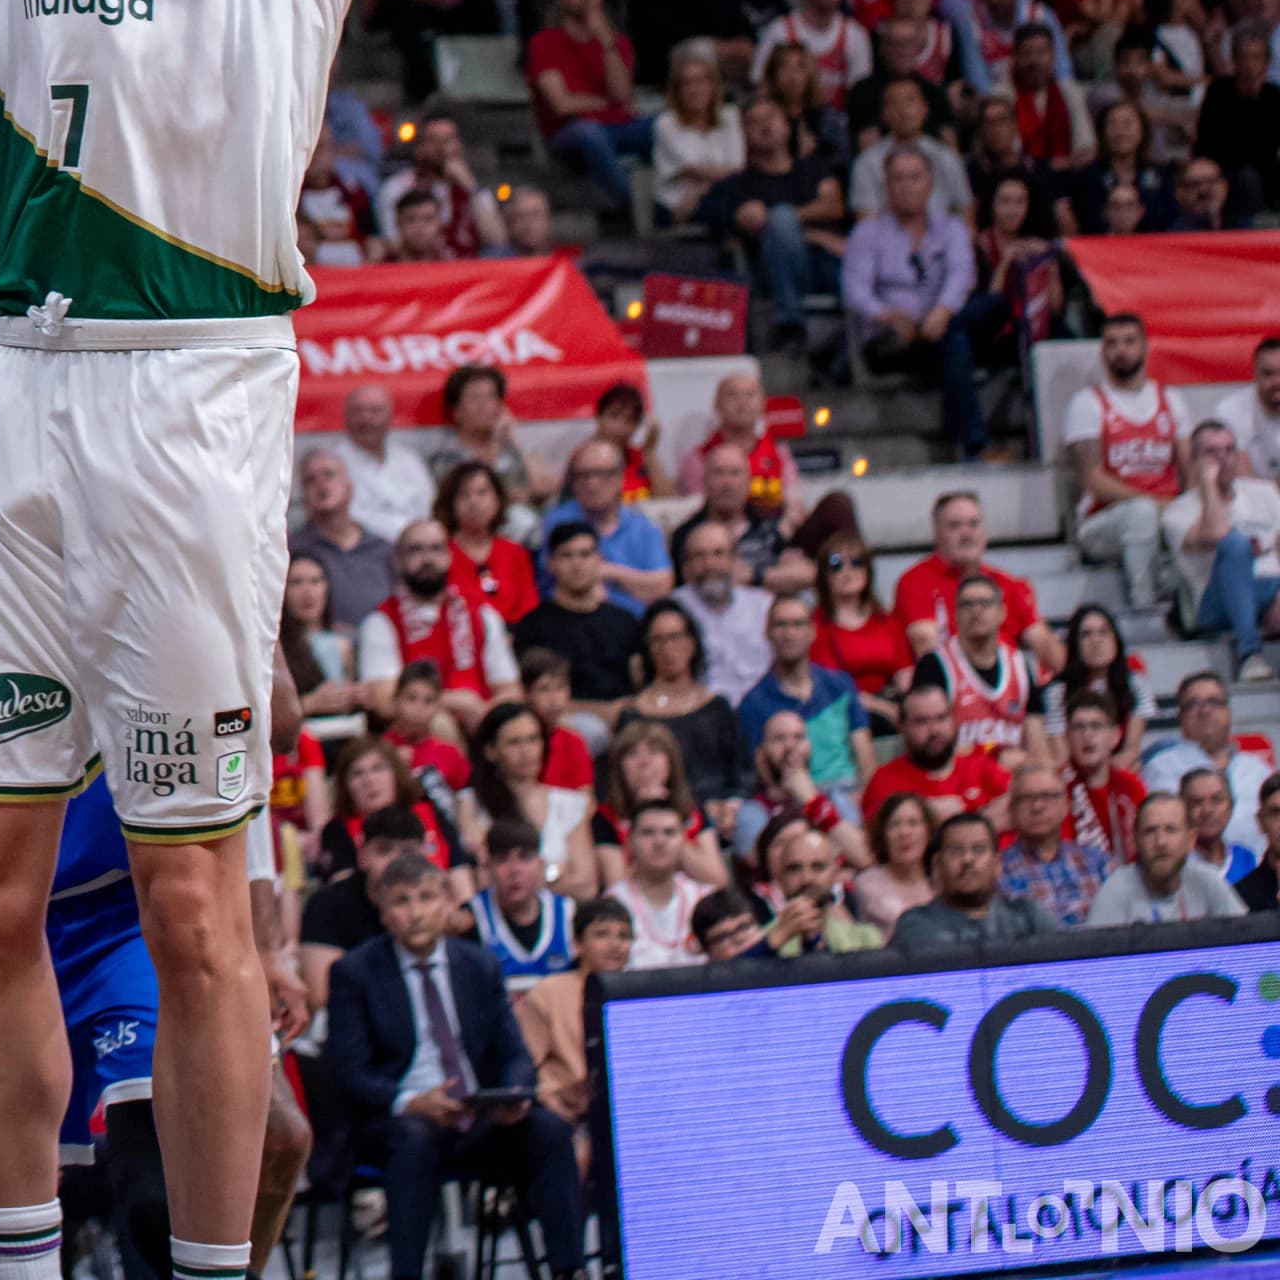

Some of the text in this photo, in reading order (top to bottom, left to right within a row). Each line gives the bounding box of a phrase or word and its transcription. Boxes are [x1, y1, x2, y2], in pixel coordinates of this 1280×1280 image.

[50, 83, 90, 168] 7
[300, 327, 563, 376] MURCIA
[217, 719, 245, 735] acb
[125, 746, 200, 798] laga
